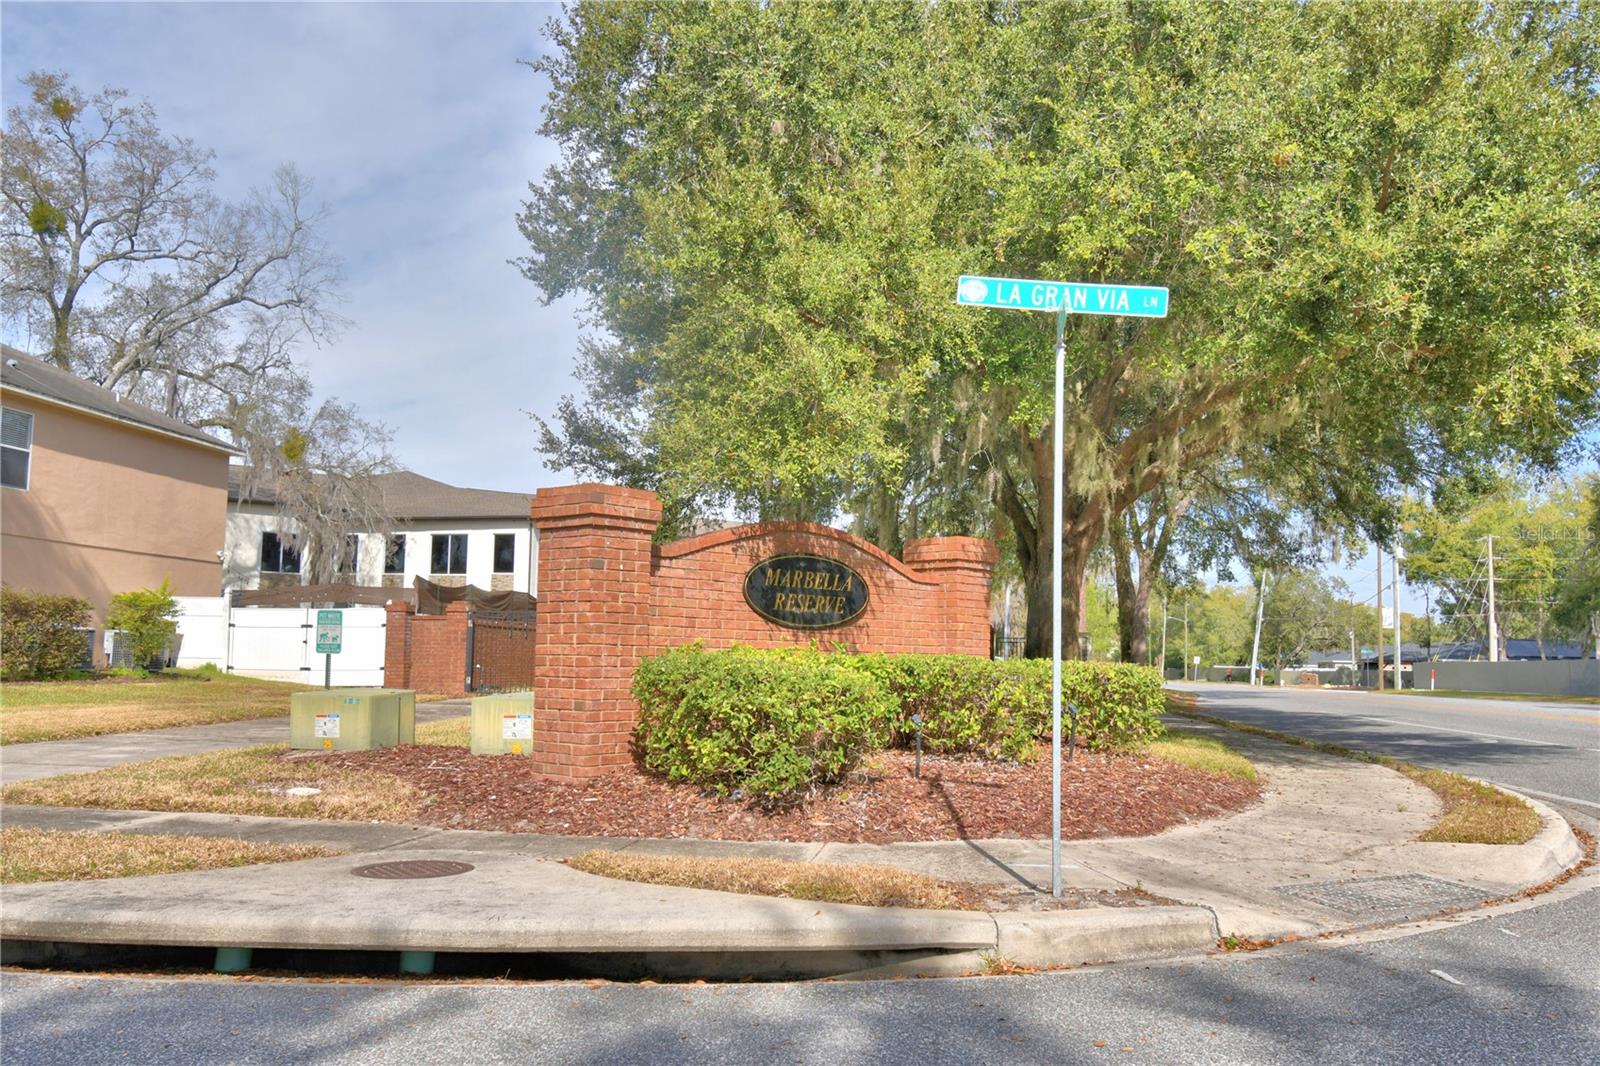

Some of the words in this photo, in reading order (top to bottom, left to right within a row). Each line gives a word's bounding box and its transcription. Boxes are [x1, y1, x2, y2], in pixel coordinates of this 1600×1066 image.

[996, 282, 1021, 304] LA
[1031, 284, 1087, 309] GRAN
[1097, 288, 1129, 311] VIA
[1143, 296, 1158, 308] LN
[765, 568, 852, 592] MARBELLA
[773, 592, 846, 614] RESERVE
